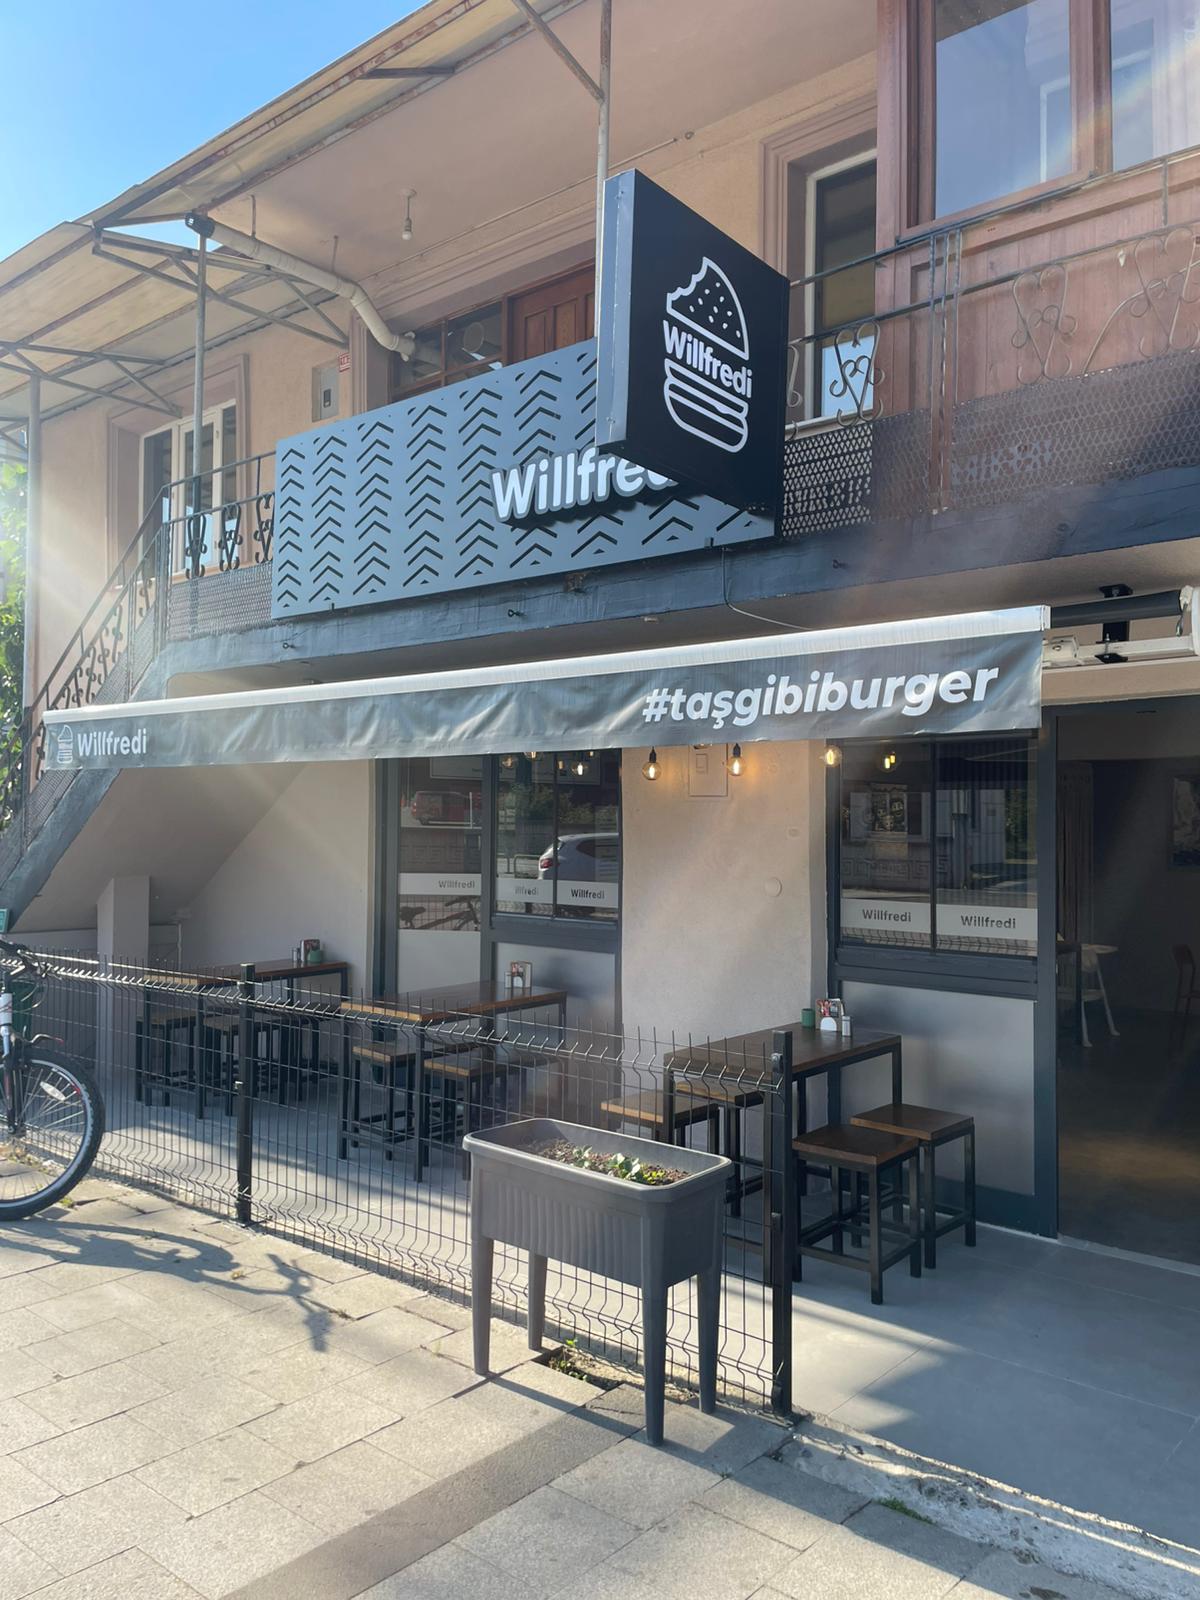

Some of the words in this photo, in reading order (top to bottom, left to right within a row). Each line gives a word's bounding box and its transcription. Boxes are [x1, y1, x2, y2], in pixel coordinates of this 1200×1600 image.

[662, 319, 753, 399] Willfredi
[642, 666, 1000, 730] #taşgibiburger
[77, 728, 147, 756] Willfredi
[438, 879, 476, 889] Willfredi
[570, 888, 605, 900] Willfredi
[861, 908, 912, 923] Willfredi
[960, 915, 1017, 930] Willfredi
